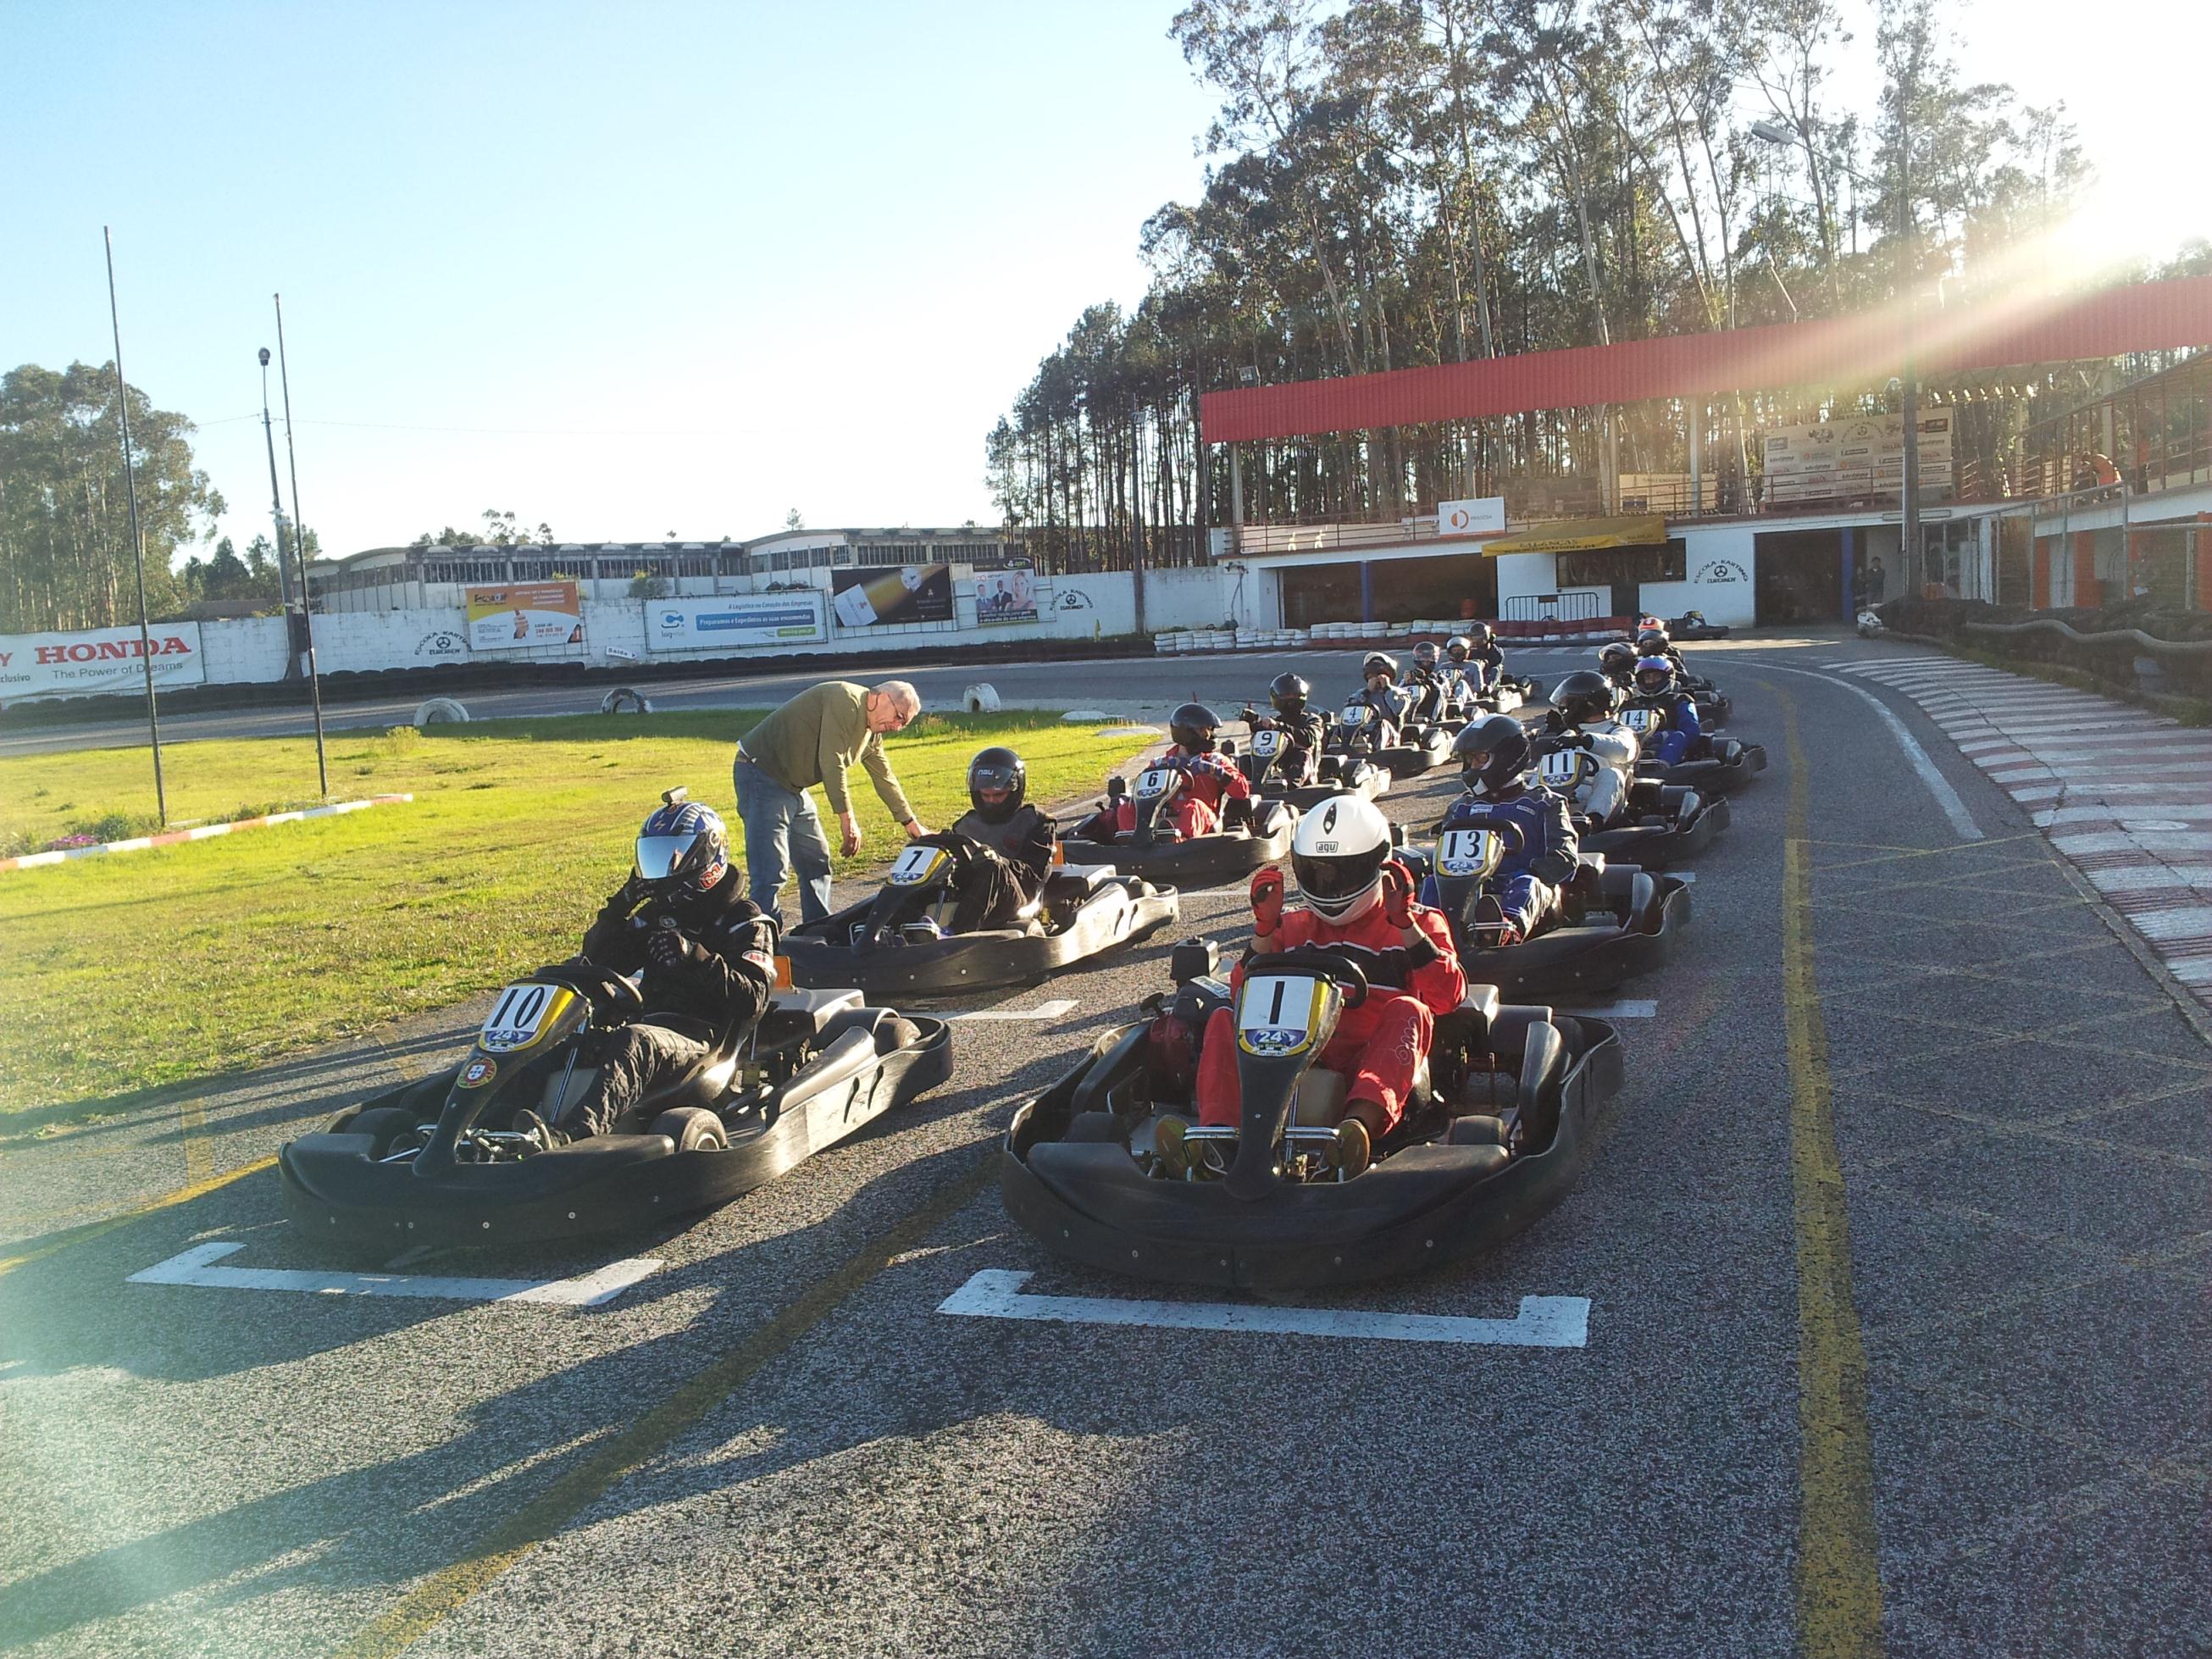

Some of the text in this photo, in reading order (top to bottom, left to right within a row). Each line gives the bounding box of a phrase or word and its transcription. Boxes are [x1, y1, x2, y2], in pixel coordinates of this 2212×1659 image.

[35, 637, 191, 665] HONDA
[52, 661, 184, 680] The Power of Deams
[1349, 707, 1357, 719] 4
[1626, 711, 1644, 725] 14
[1260, 732, 1272, 746] 9
[1549, 753, 1568, 774] 11
[1147, 772, 1159, 787] 6
[1448, 830, 1481, 858] 13
[904, 850, 923, 872] 7
[490, 986, 545, 1029] 10
[1268, 980, 1286, 1024] 1
[494, 1030, 513, 1040] 24
[1258, 1031, 1283, 1043] 24
